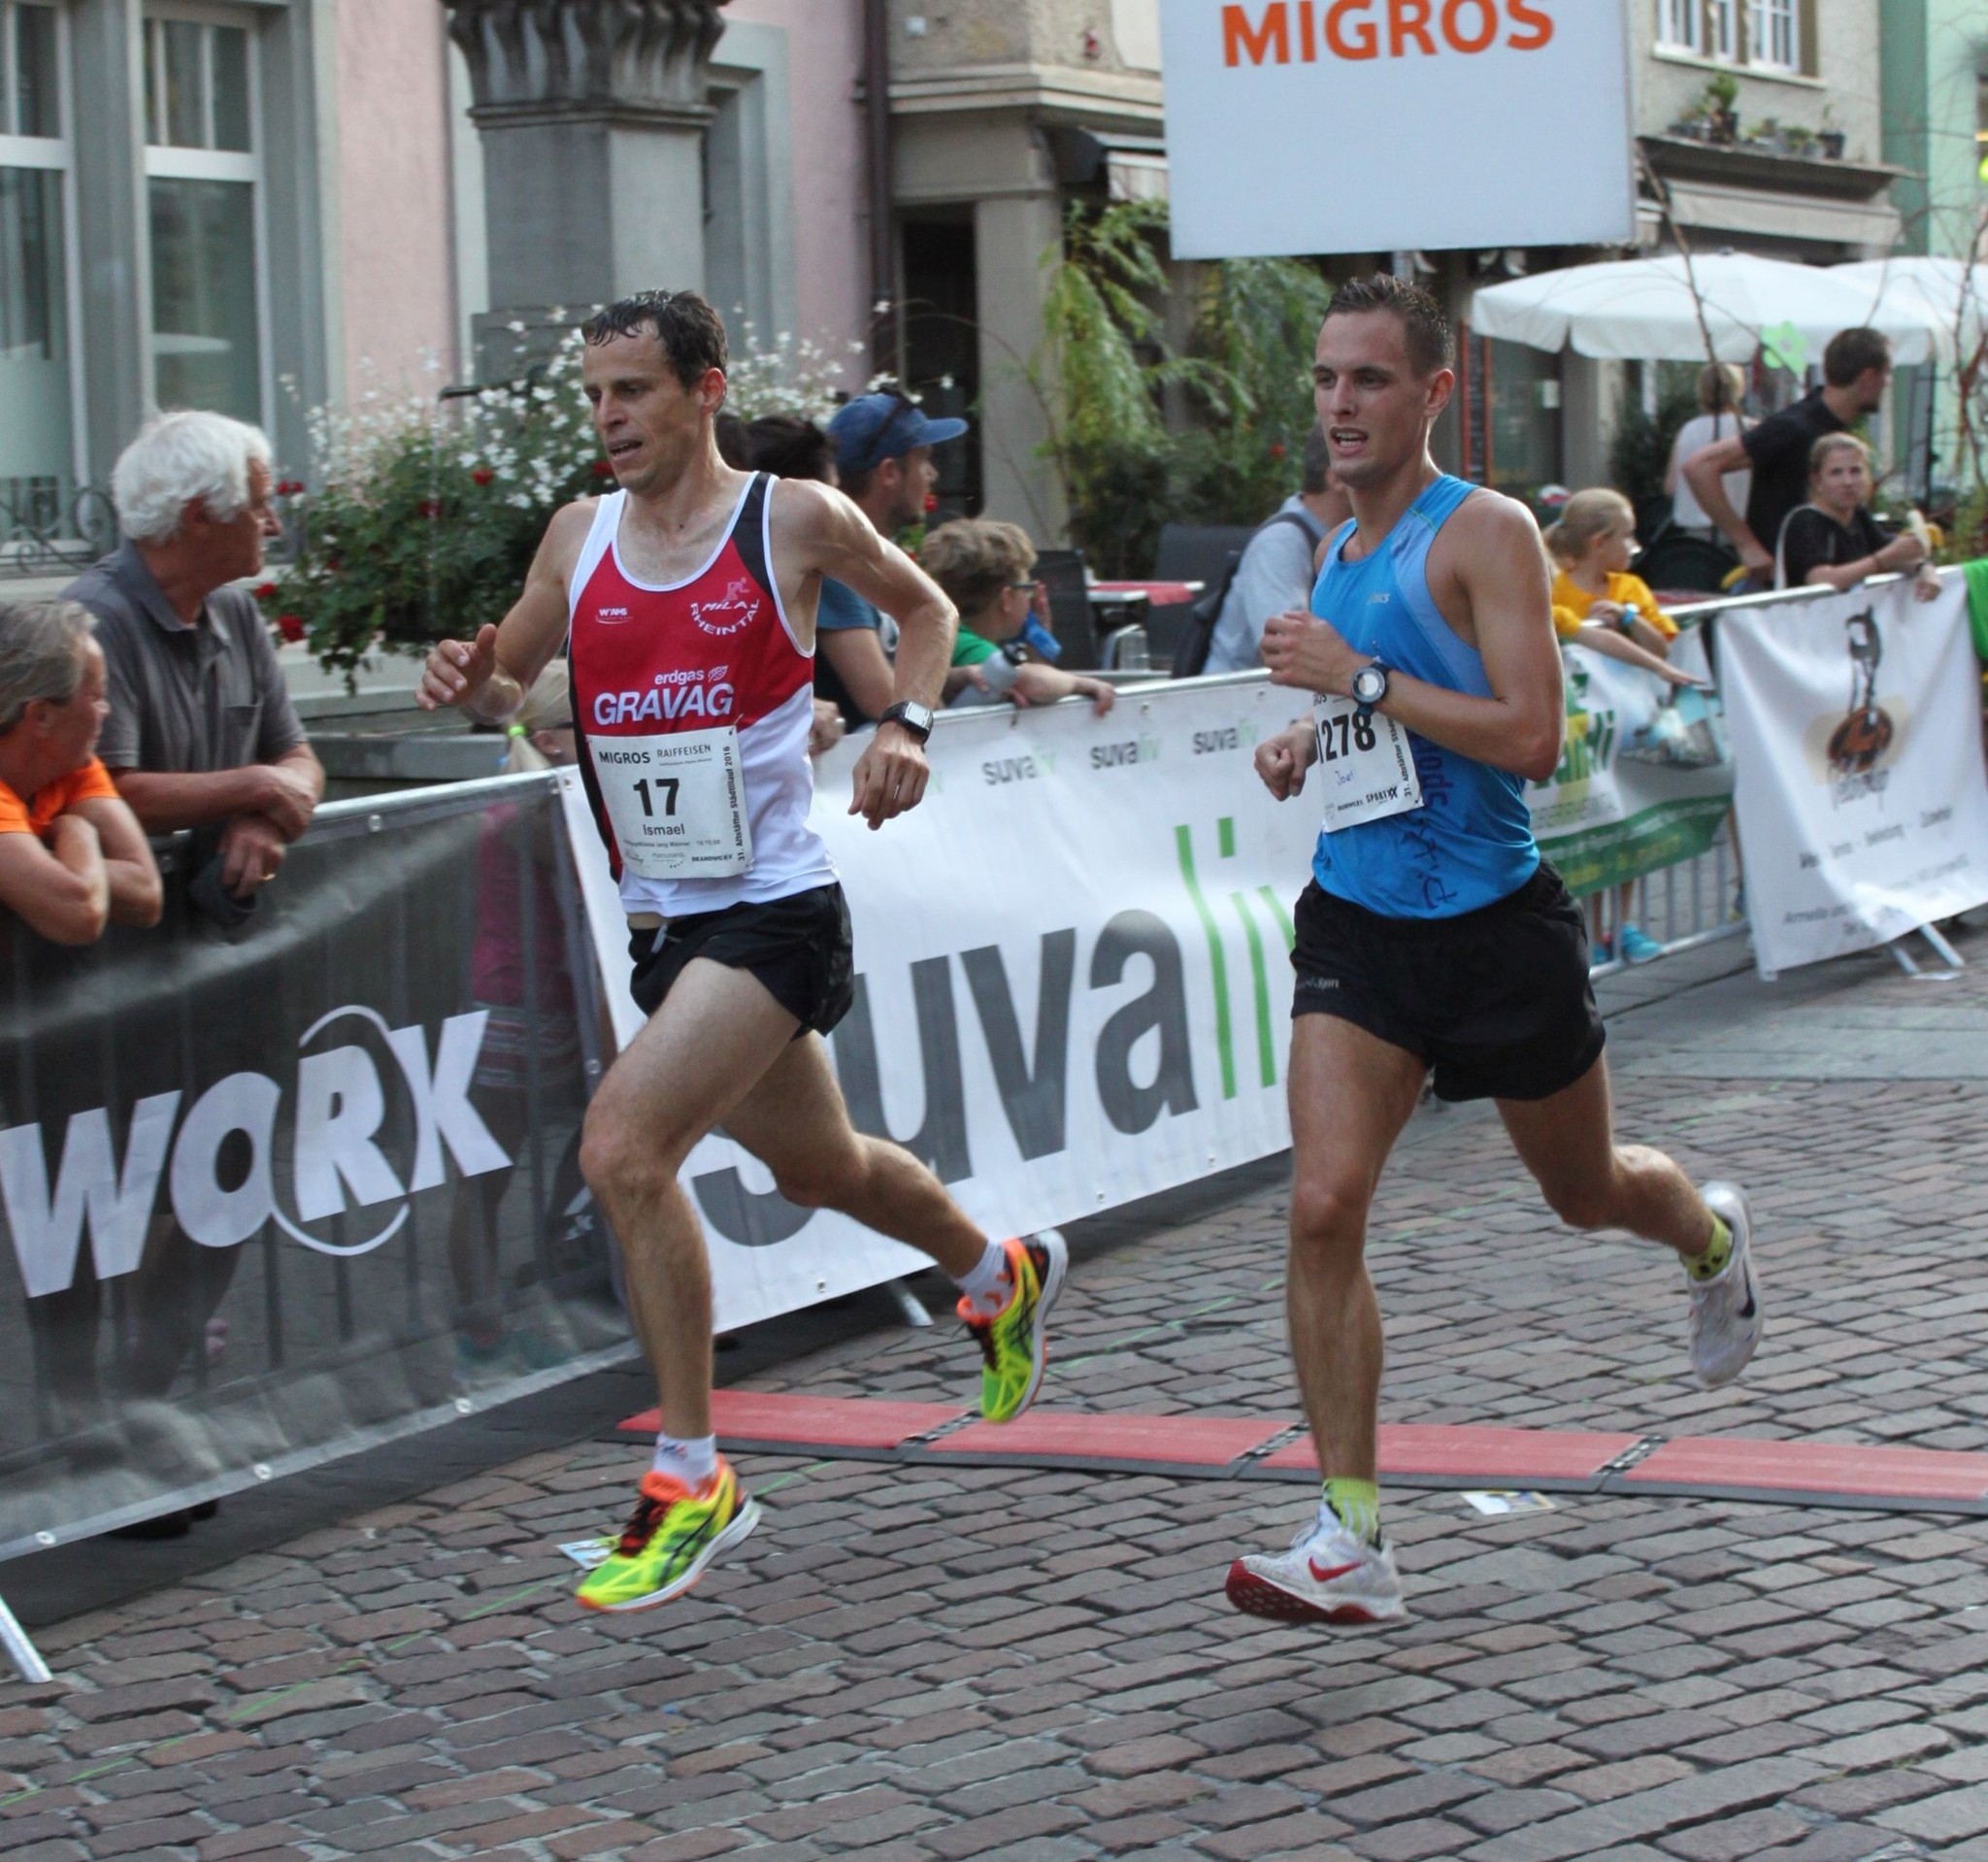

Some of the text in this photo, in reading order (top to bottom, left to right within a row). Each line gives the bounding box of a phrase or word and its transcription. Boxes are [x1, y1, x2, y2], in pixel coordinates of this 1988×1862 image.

[1221, 0, 1555, 68] MIGROS
[690, 599, 760, 636] RHEINTAL
[654, 669, 705, 685] erdgas
[594, 683, 734, 725] GRAVAG
[598, 750, 650, 764] MIGROS
[656, 744, 712, 758] RAIFFEISEN
[722, 746, 732, 766] 2016
[633, 778, 679, 816] 17
[644, 823, 684, 836] Ismael
[0, 1010, 513, 1297] WORK
